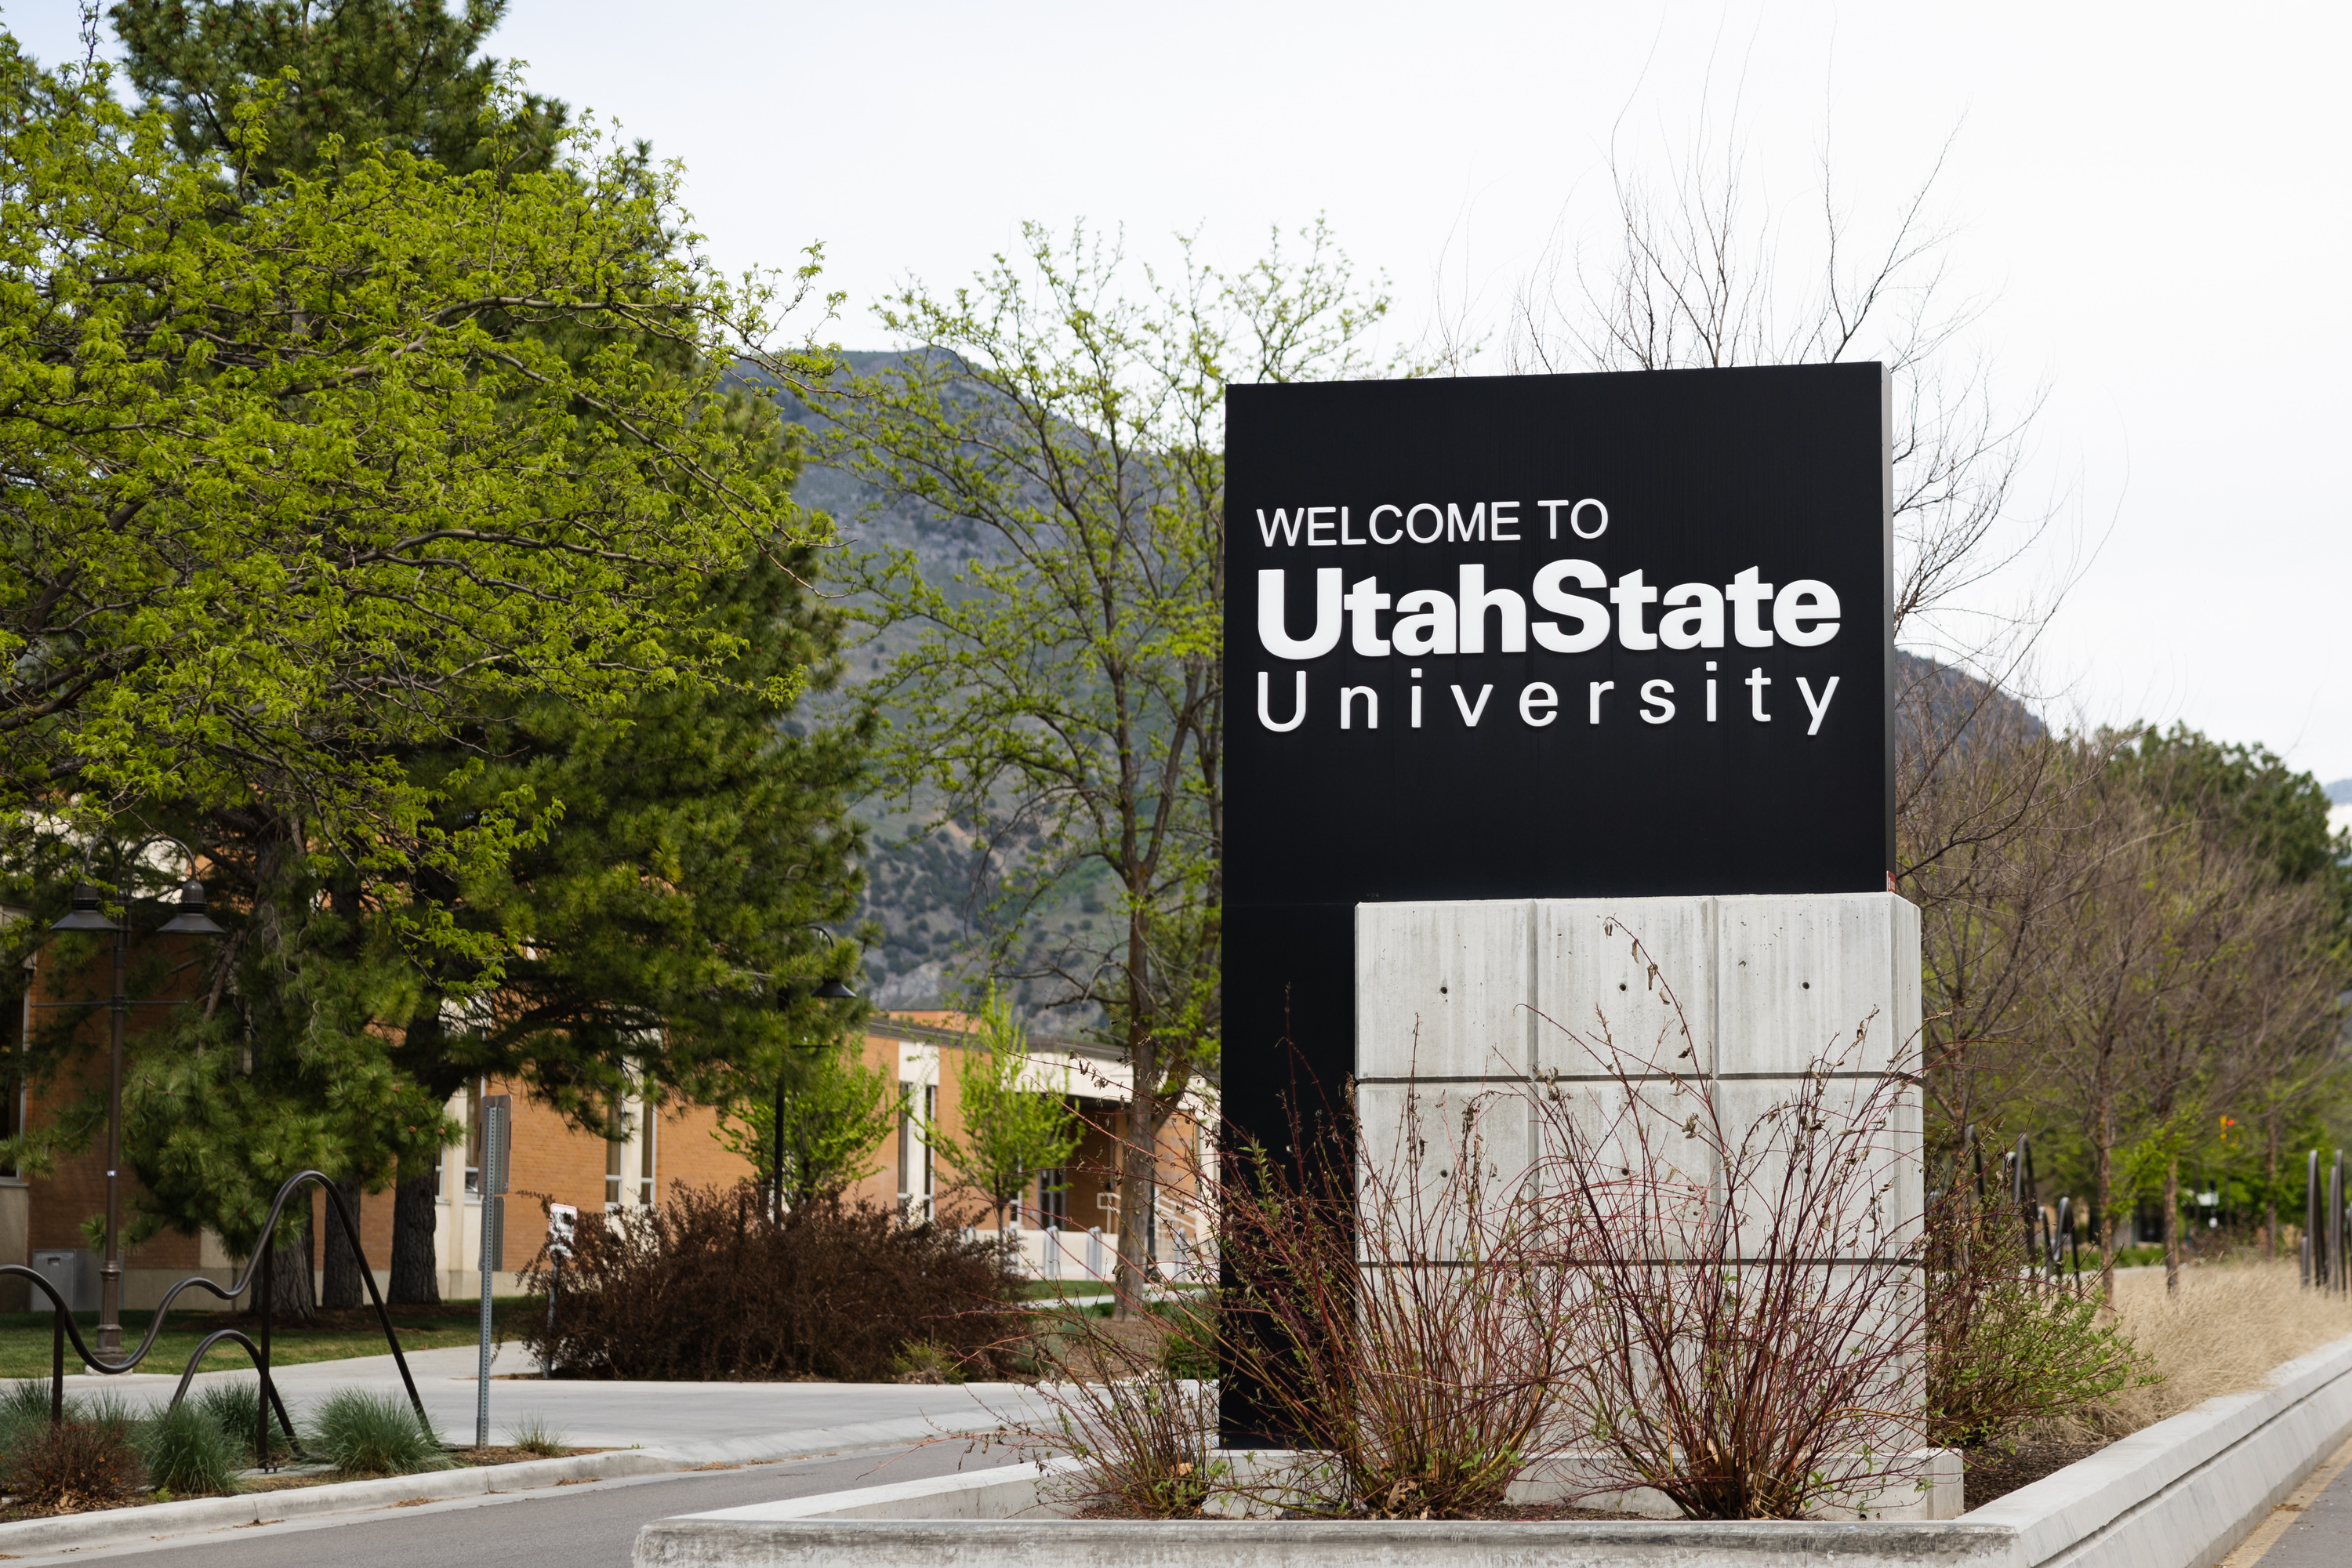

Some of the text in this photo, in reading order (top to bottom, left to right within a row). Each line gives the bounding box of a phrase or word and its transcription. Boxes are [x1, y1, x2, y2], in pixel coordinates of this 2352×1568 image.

[1256, 498, 1610, 547] WELCOME TO
[1258, 558, 1842, 660] UtahState
[1258, 660, 1840, 735] University
